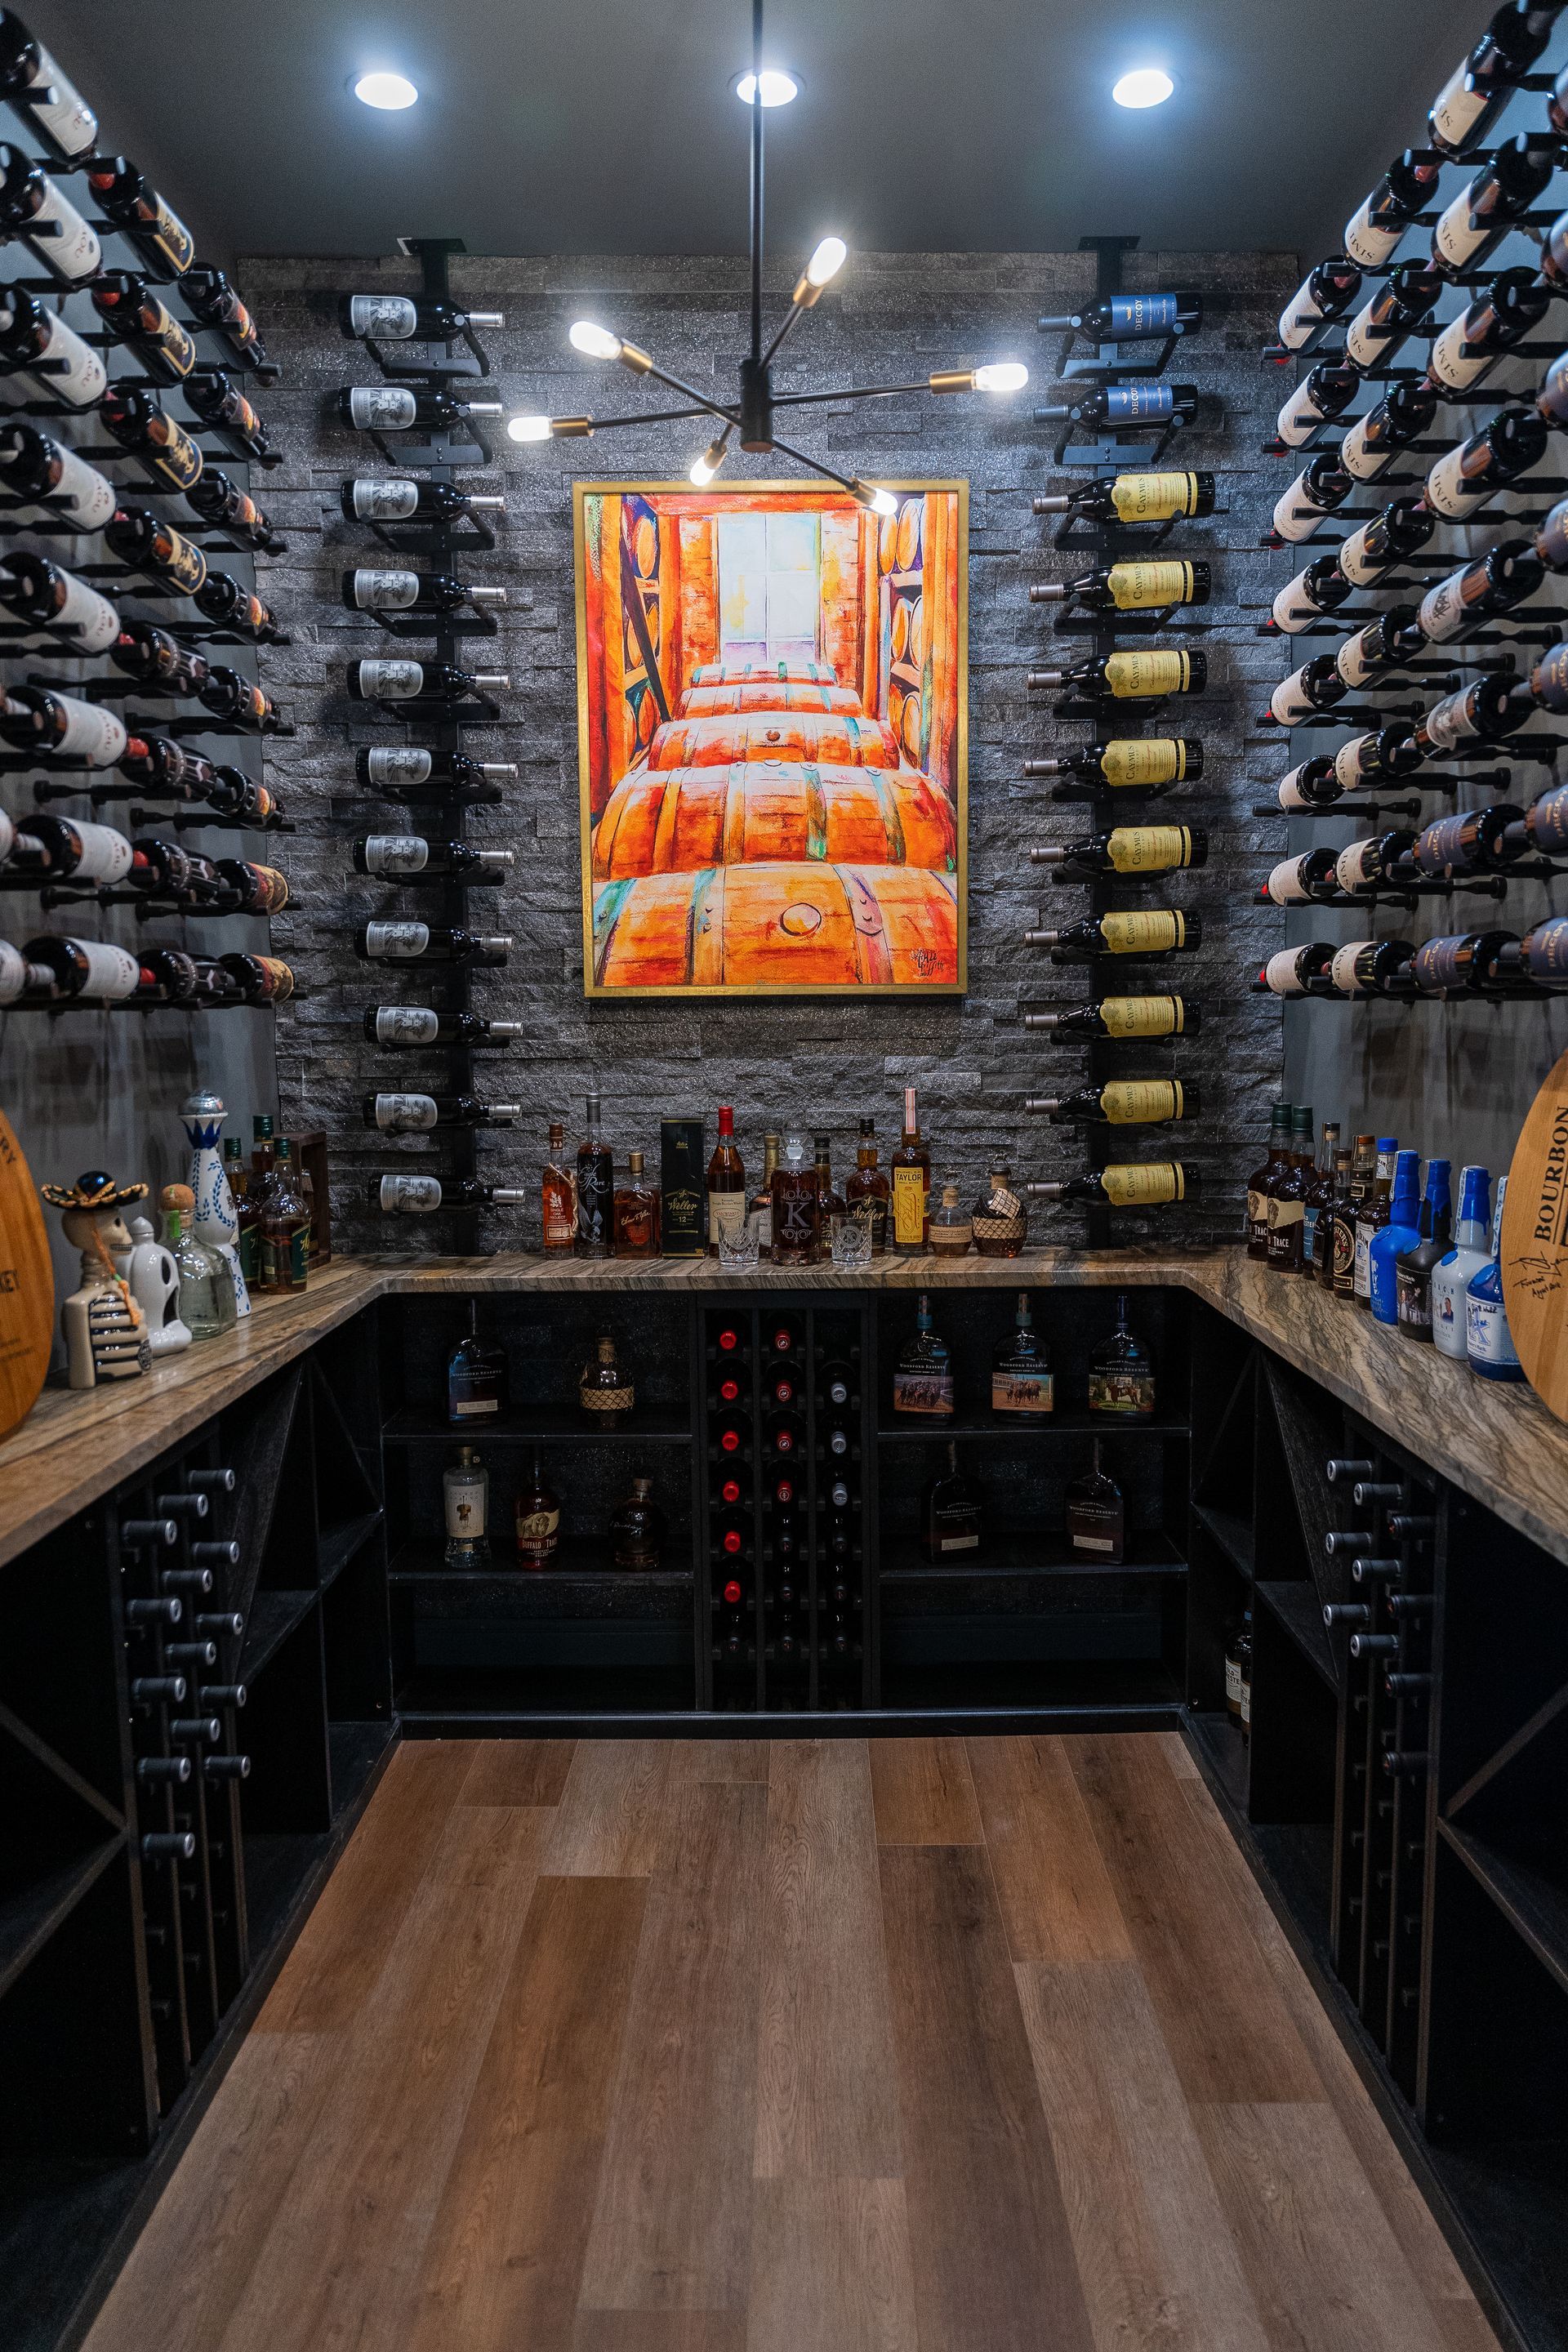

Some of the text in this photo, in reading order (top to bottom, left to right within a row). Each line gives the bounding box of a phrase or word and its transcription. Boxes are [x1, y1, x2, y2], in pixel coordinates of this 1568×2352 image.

[1349, 232, 1375, 260] SIMI
[1134, 299, 1143, 331] DECOY
[1437, 341, 1459, 379] SIMI
[1130, 387, 1139, 415] DECOY
[1345, 438, 1363, 470] SIMI
[1136, 477, 1147, 514] CAYMUS
[1434, 474, 1456, 510] SIMI
[1344, 543, 1359, 577] SIMI
[1133, 565, 1143, 600] CAYMUS
[1130, 655, 1139, 689] CAYMUS
[1126, 745, 1135, 780] CAYMUS
[1132, 831, 1142, 866] CAYMUS
[1126, 913, 1135, 945] CAYMUS
[1125, 998, 1134, 1030] CAYMUS
[1125, 1085, 1134, 1118] CAYMUS
[896, 1174, 922, 1182] TAYLOR
[1127, 1166, 1135, 1198] CAYMUS
[1534, 1106, 1568, 1242] BOURBON
[667, 1198, 698, 1211] Weller
[784, 1201, 810, 1227] K
[1273, 1236, 1290, 1248] TRACE
[522, 1539, 541, 1549] BUFFALO
[1227, 1676, 1240, 1685] ESTE
